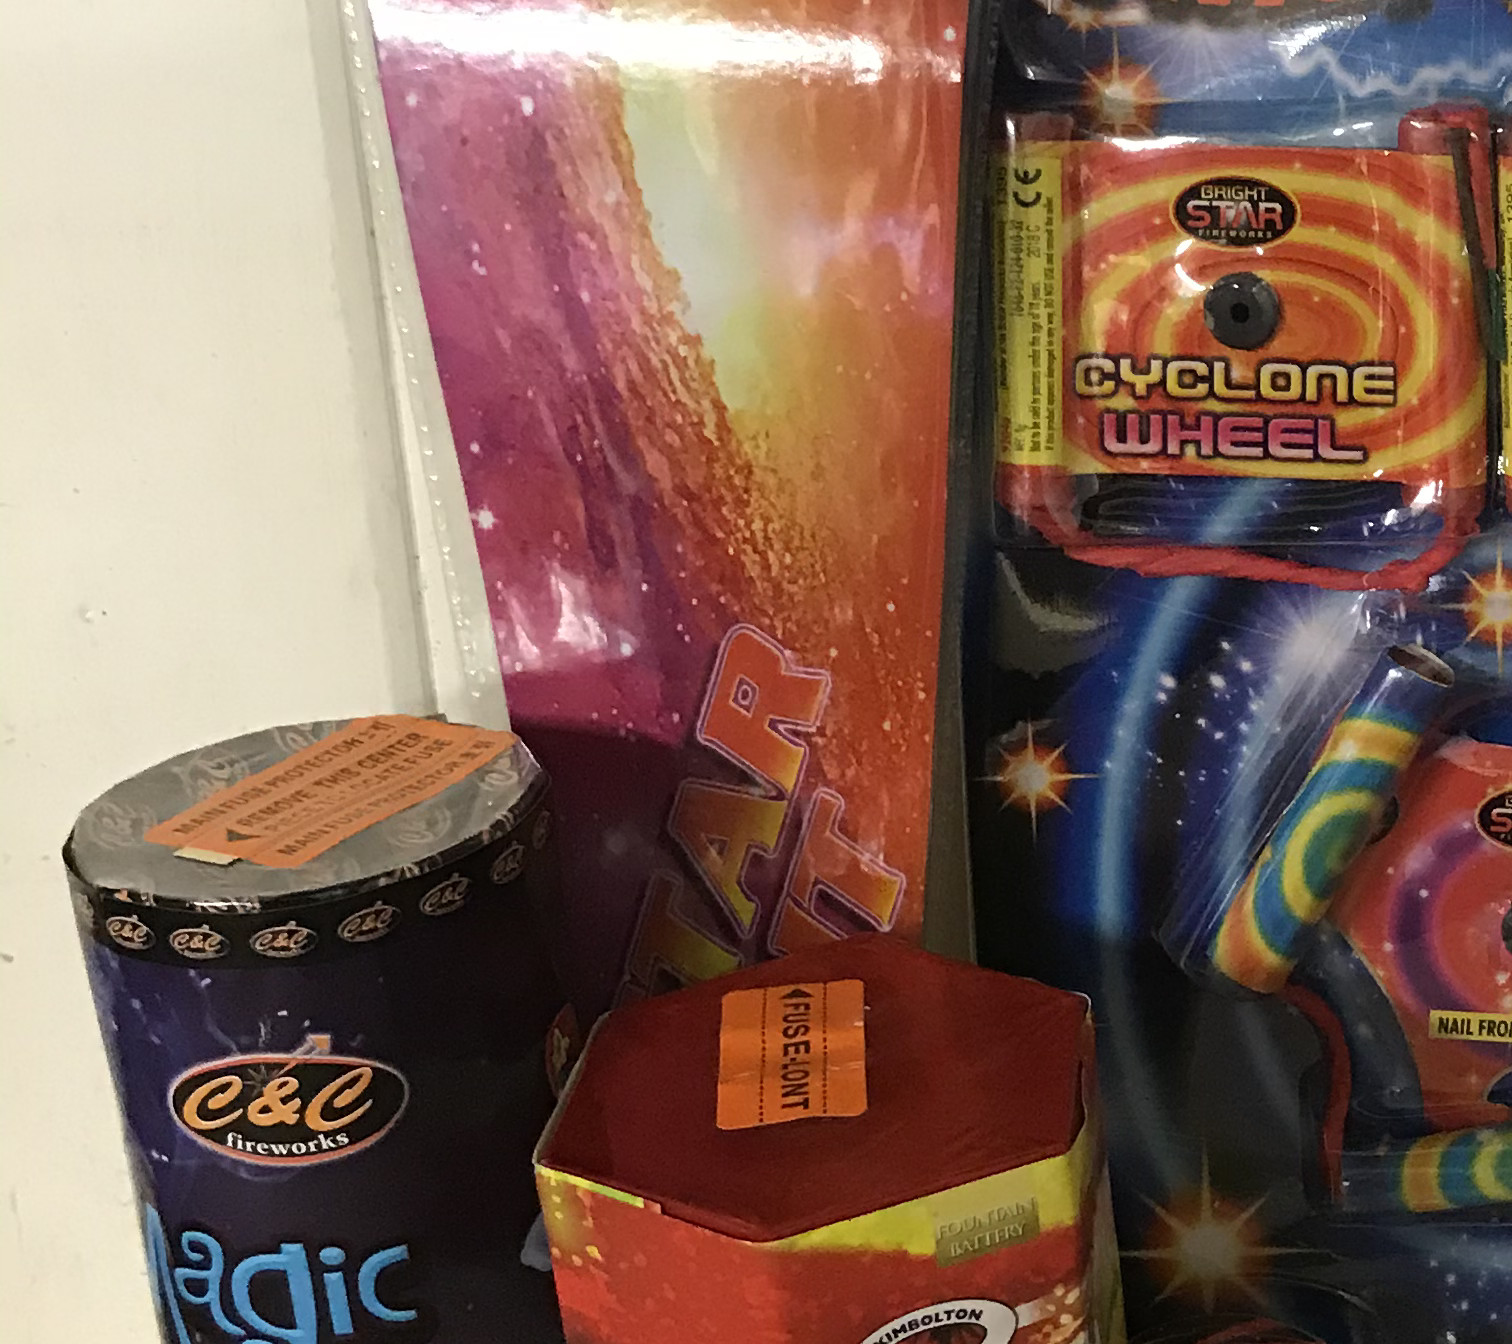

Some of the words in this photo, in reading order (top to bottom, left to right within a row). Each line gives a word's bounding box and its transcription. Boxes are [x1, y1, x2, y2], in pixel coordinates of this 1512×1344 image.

[1201, 185, 1268, 200] BRIGHT
[1187, 201, 1284, 230] STAR
[1198, 228, 1273, 239] FIREWORKS
[1074, 356, 1398, 406] CYCLONE
[1102, 412, 1367, 462] WHEEL
[1437, 1016, 1473, 1036] NAIL
[182, 1066, 374, 1131] C&C
[226, 1130, 350, 1157] fireworks
[936, 1197, 1038, 1240] FOUNTAIN
[950, 1222, 1026, 1257] BATTERY
